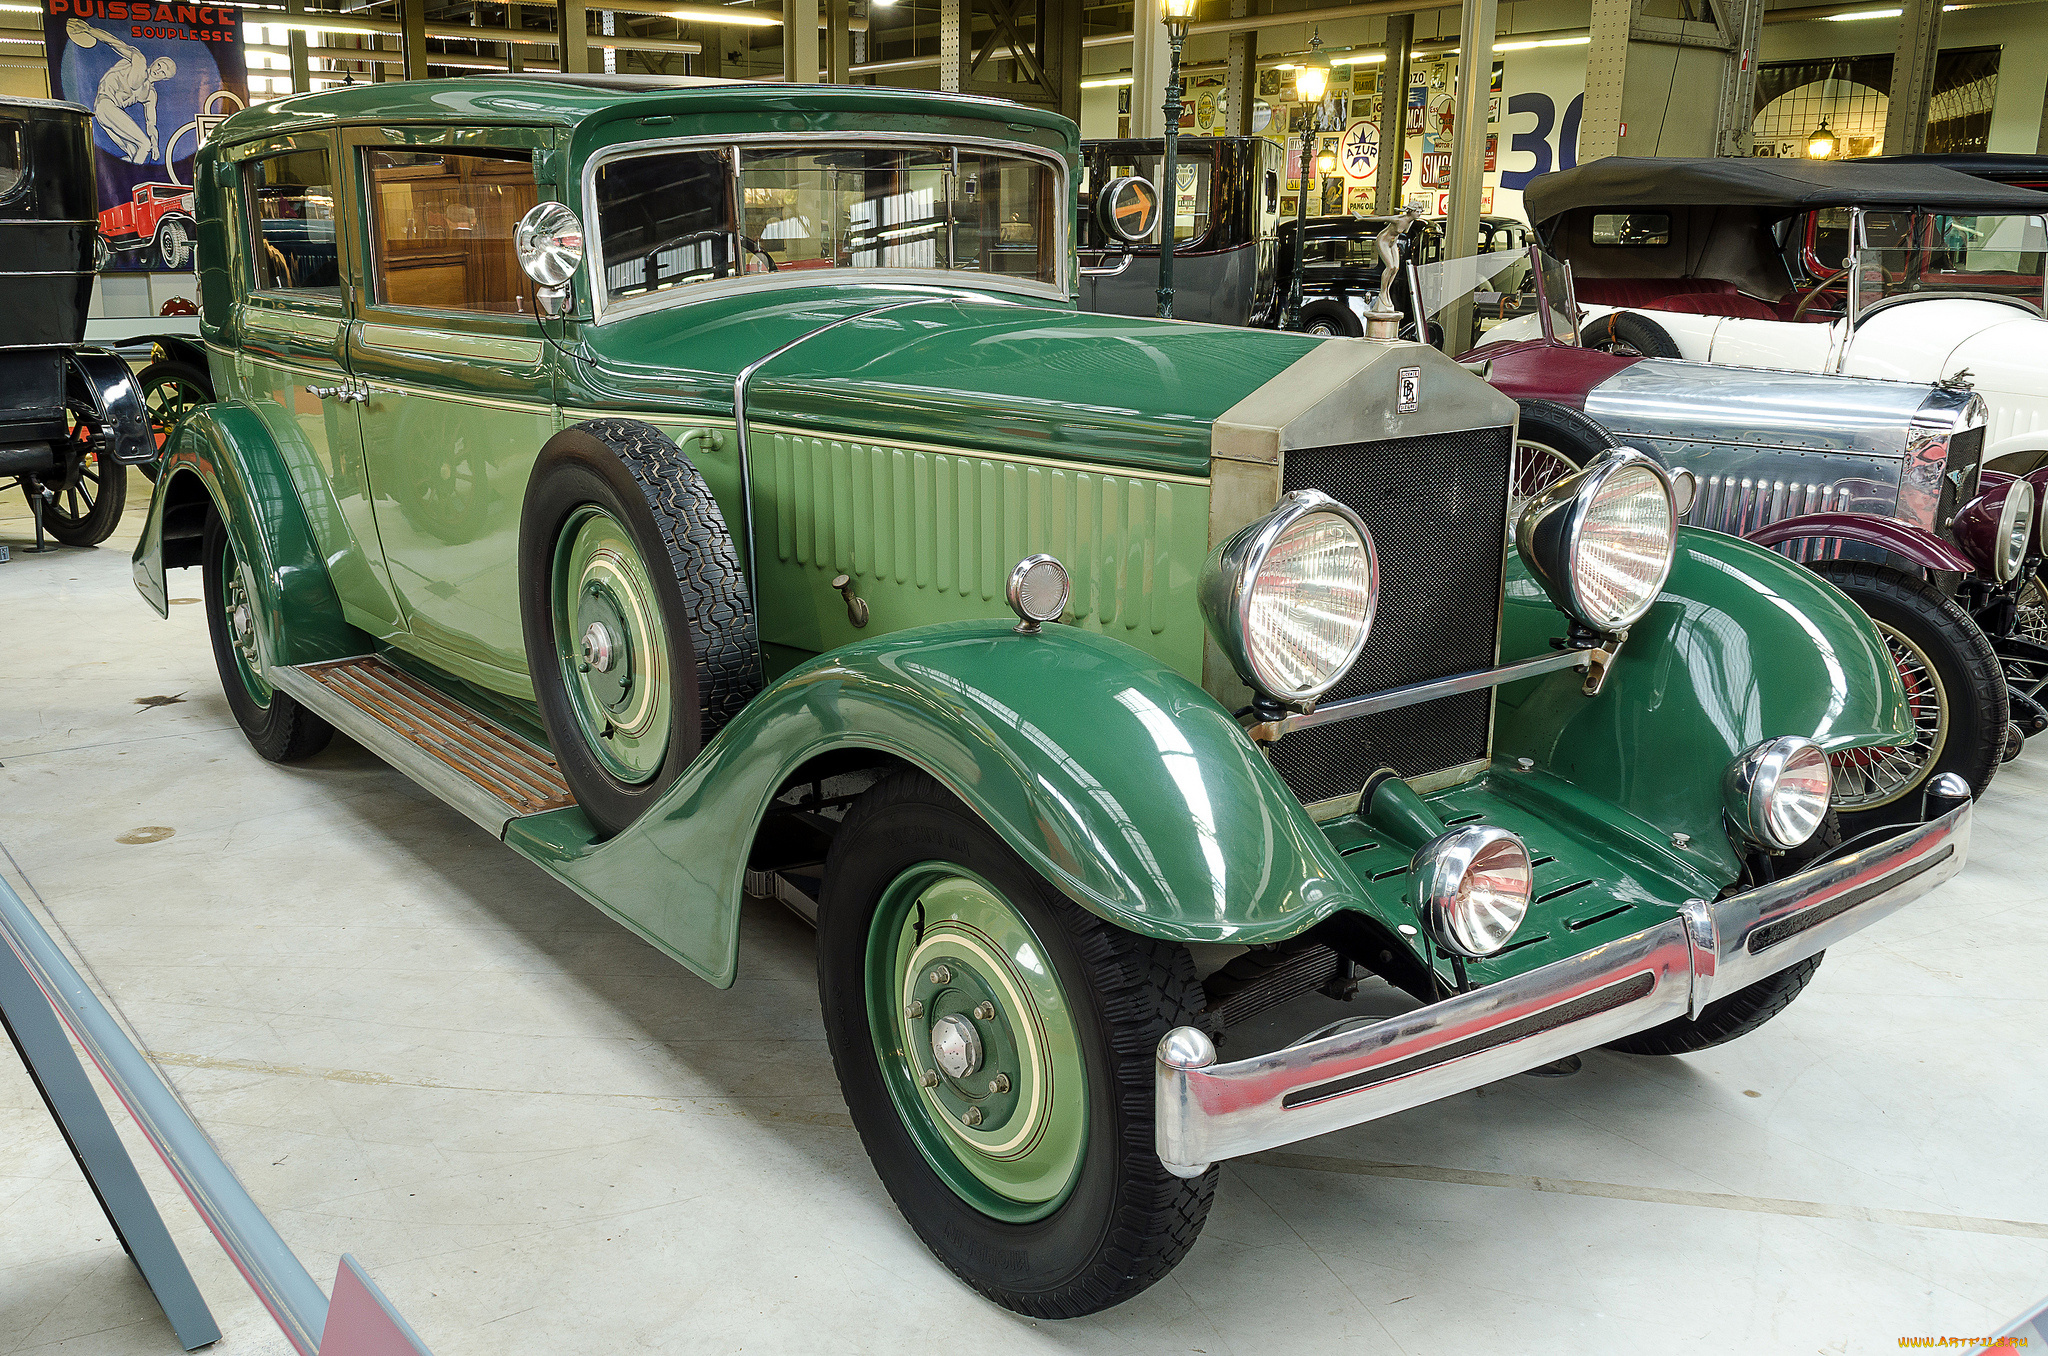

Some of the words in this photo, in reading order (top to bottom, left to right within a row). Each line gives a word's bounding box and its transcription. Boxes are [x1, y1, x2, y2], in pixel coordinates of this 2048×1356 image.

[51, 0, 236, 26] PUISSANCE
[131, 26, 234, 42] SOUPLESSE
[1346, 145, 1378, 159] AZUR
